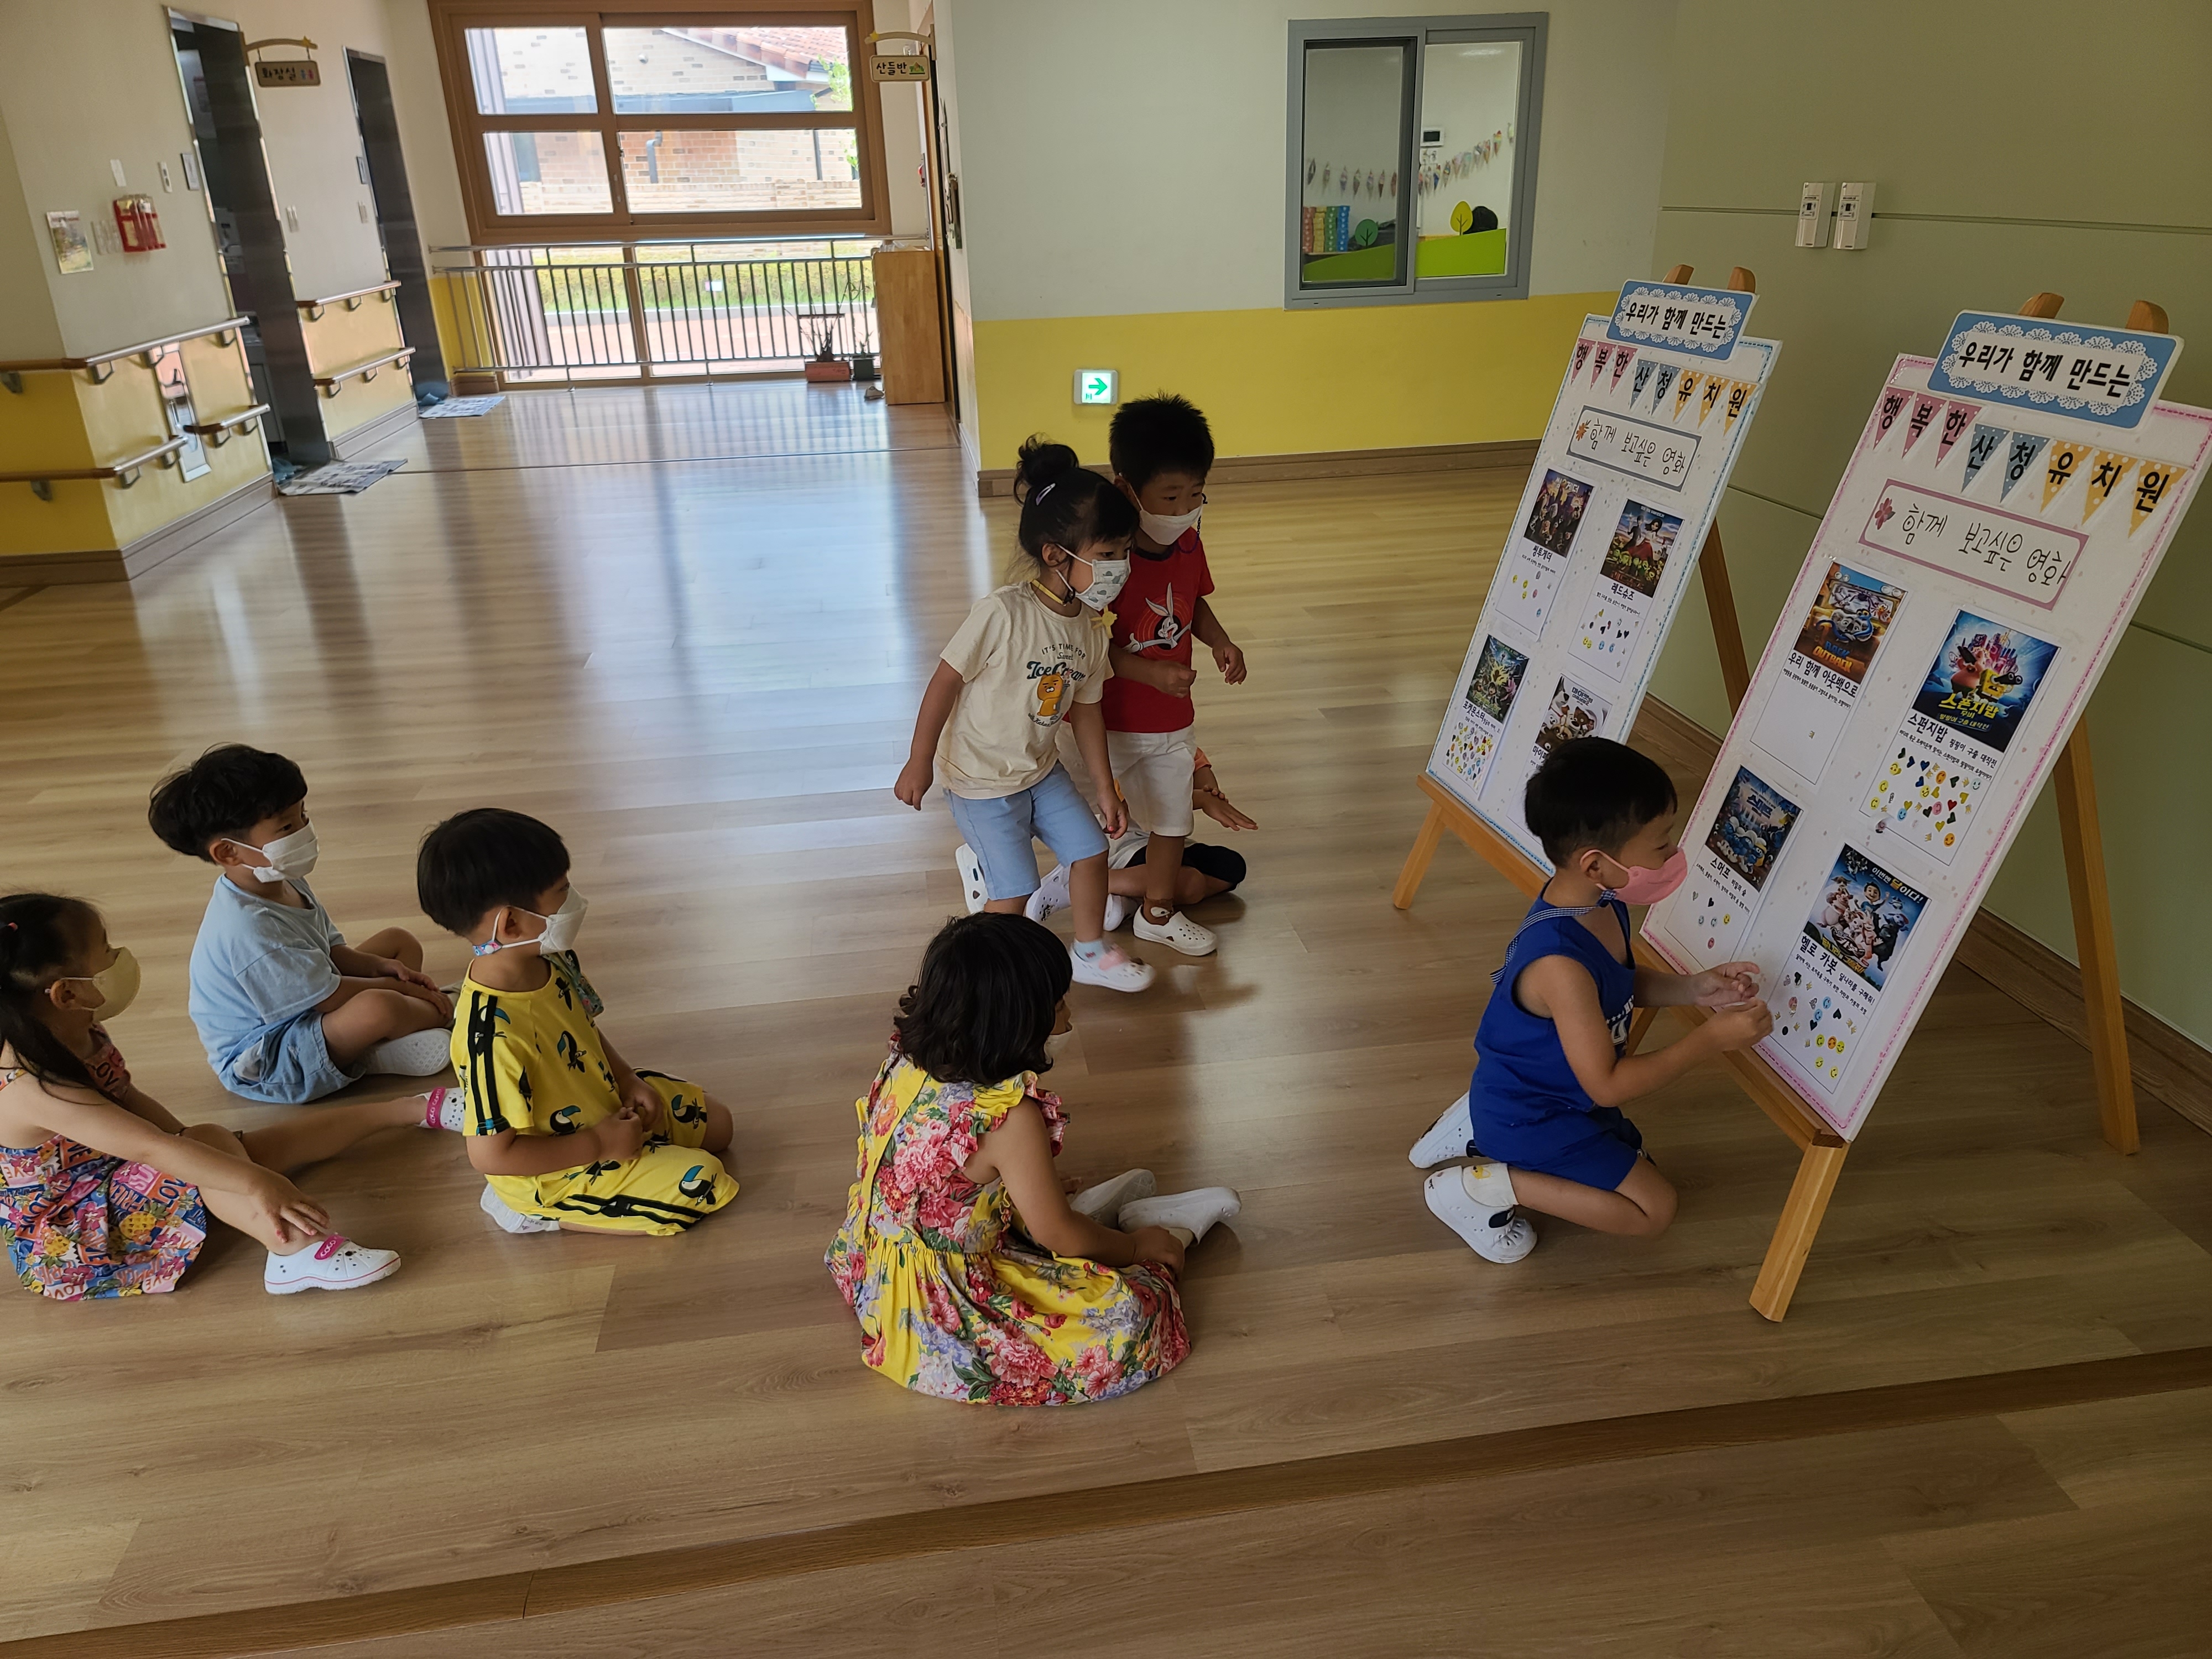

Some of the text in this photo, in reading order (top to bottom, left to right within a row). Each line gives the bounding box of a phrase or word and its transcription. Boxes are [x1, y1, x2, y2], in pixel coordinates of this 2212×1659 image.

[262, 67, 296, 81] 화장실
[876, 61, 907, 75] 산들반
[1625, 301, 1726, 340] 우리가 함께 만드는
[1576, 343, 1628, 378] 행복한
[1958, 341, 2131, 398] 우리가 함께 만드는
[1881, 394, 1966, 446] 행복한
[1590, 418, 1616, 451] 함께
[1662, 447, 1686, 476] 영화
[1902, 503, 2070, 587] 함께 보고싶은 영화
[1611, 583, 1635, 601] 레드슈즈
[1041, 643, 1087, 660] IT'S TIME FOR
[1812, 645, 1853, 673] OUTBACK
[1788, 652, 1858, 698] 우리 함께 아웃백으로
[1463, 701, 1485, 722] 포켓몬스터
[1938, 693, 2000, 719] 스폰지밥
[1908, 713, 1997, 769] 스펀지밥 핑핑이 구출 대작전
[1710, 858, 1731, 879] 스머프
[1872, 867, 1892, 883] 이번엔
[1800, 936, 1875, 1005] 헬로 카봇 달나라를 구해줘!
